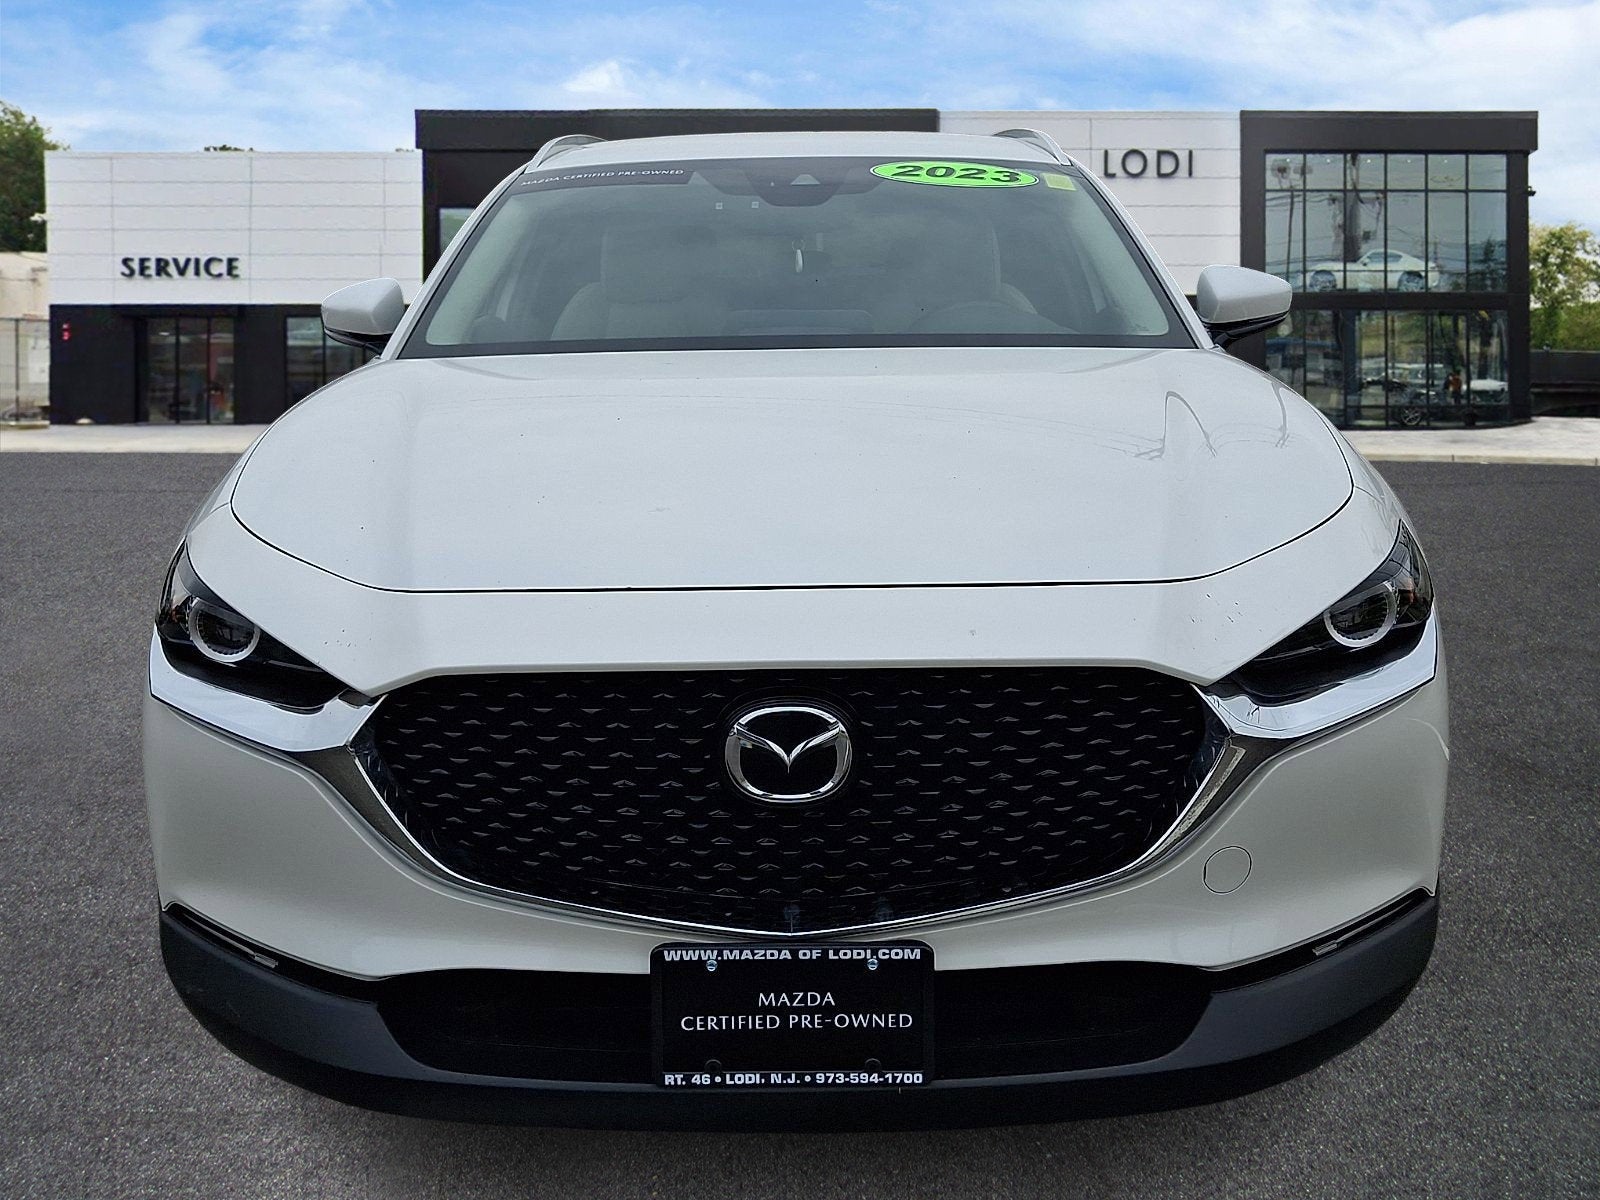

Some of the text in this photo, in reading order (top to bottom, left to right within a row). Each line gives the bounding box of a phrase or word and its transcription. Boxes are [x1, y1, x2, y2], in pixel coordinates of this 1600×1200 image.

[1103, 149, 1194, 179] LODI
[520, 176, 560, 186] MAZDA
[563, 172, 616, 180] CERTIFIED
[890, 164, 1022, 184] 2023
[120, 256, 241, 278] SERVICE
[663, 948, 921, 961] WWW.MAZDA OF LODI.COM
[758, 991, 836, 1007] MAZDA
[680, 1013, 914, 1031] CERTIFIED PRE-OWNED
[664, 1074, 686, 1086] RT.
[691, 1074, 711, 1085] 46
[770, 1073, 801, 1085] N.J.
[815, 1072, 924, 1085] 973-594-1700
